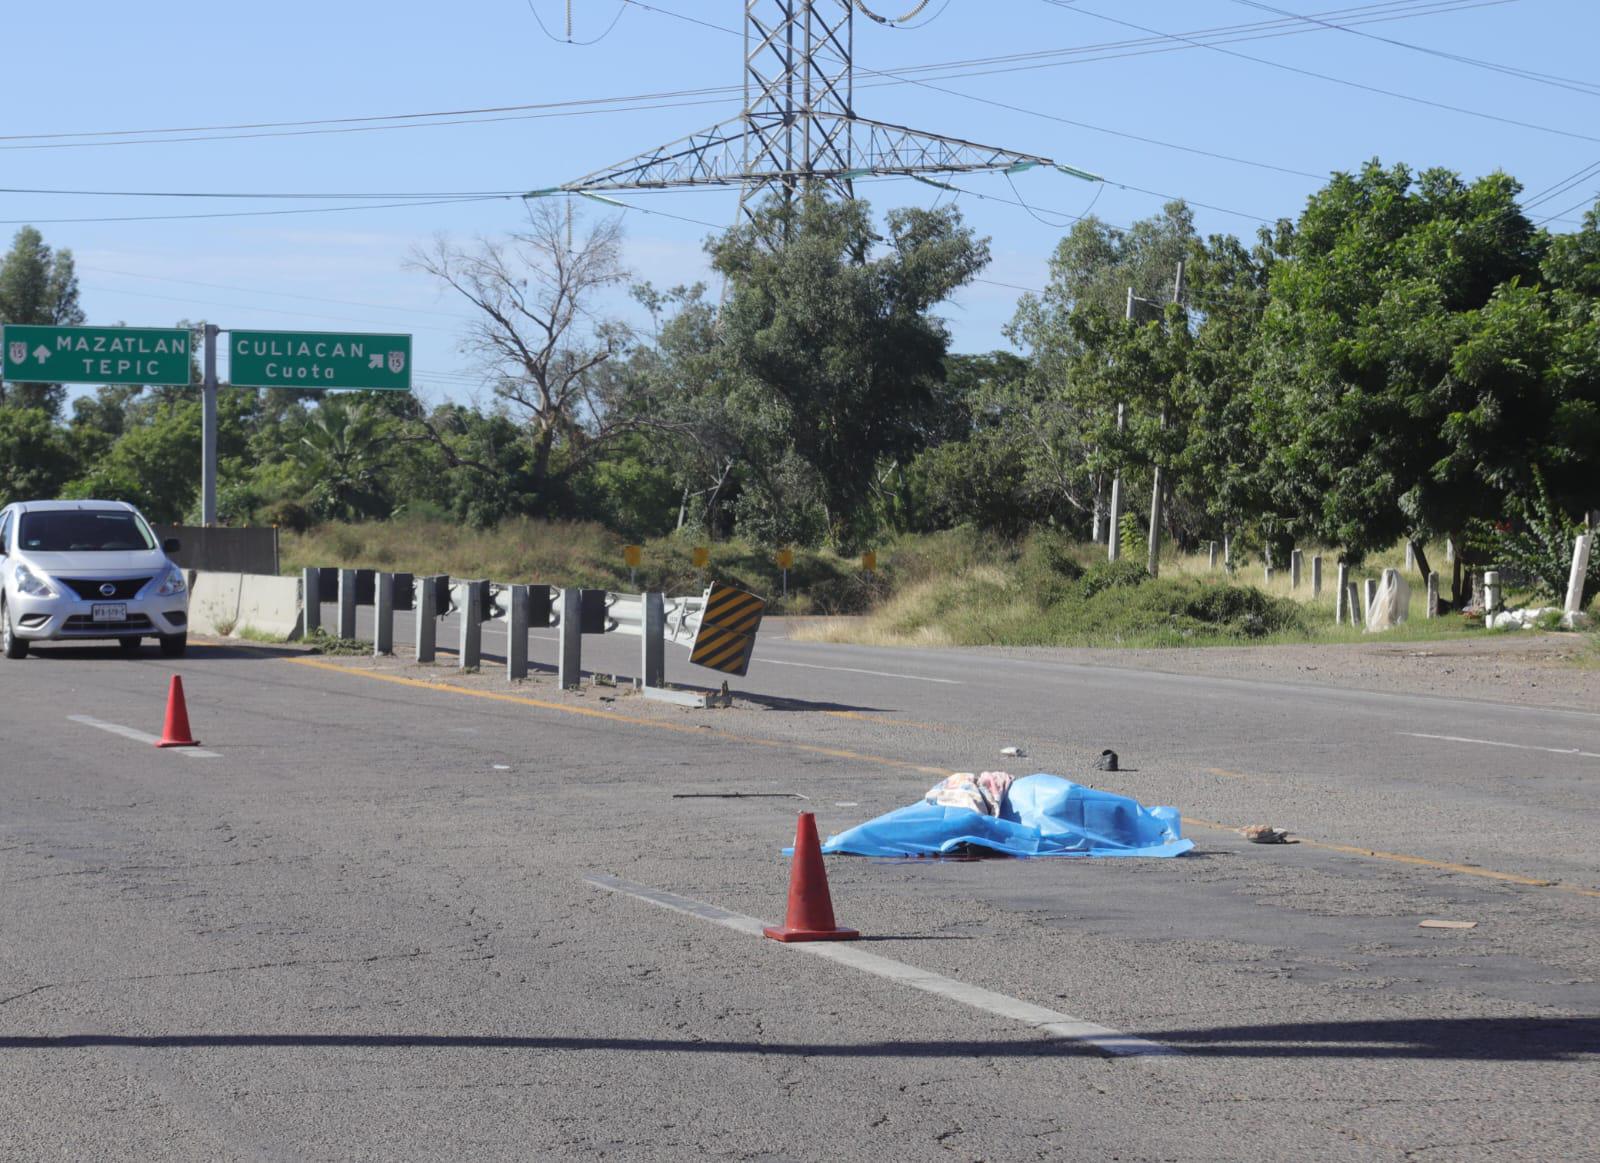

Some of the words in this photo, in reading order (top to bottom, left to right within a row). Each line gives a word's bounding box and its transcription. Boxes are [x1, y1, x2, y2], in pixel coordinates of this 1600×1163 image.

[57, 336, 185, 354] MAZATLAN
[237, 340, 364, 357] CULIACAN
[12, 348, 24, 359] 15
[82, 359, 160, 375] TEPIC
[265, 363, 335, 379] Cuota
